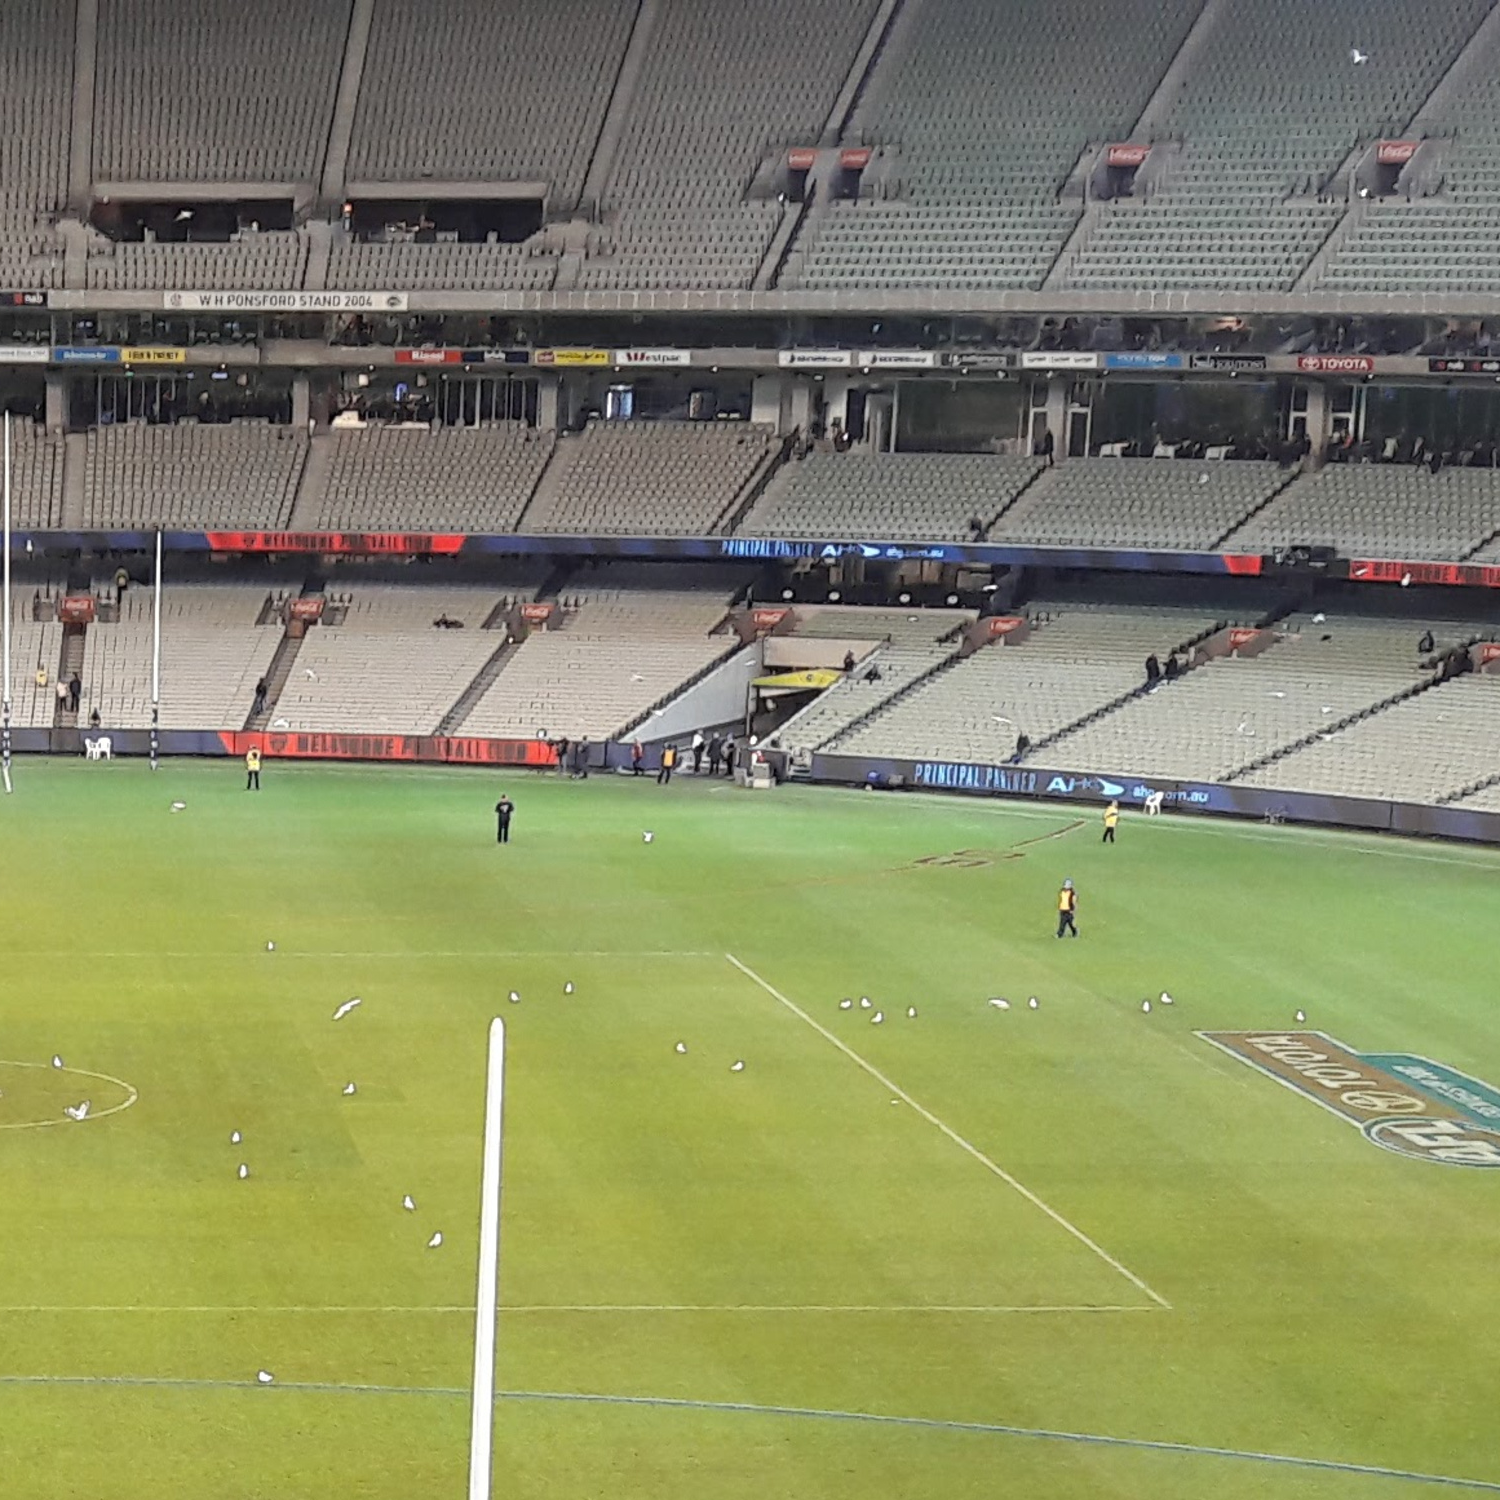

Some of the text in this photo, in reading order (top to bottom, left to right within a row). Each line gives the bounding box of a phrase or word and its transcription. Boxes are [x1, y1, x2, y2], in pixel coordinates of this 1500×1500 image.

[199, 295, 212, 306] W
[214, 295, 224, 306] H
[227, 295, 296, 307] PONSFORD
[300, 295, 341, 307] STAND
[626, 352, 680, 363] Westpac
[1322, 358, 1368, 370] TOYOTA
[913, 763, 980, 788] PRINCIPAL
[1245, 1033, 1379, 1090] TOYOTA
